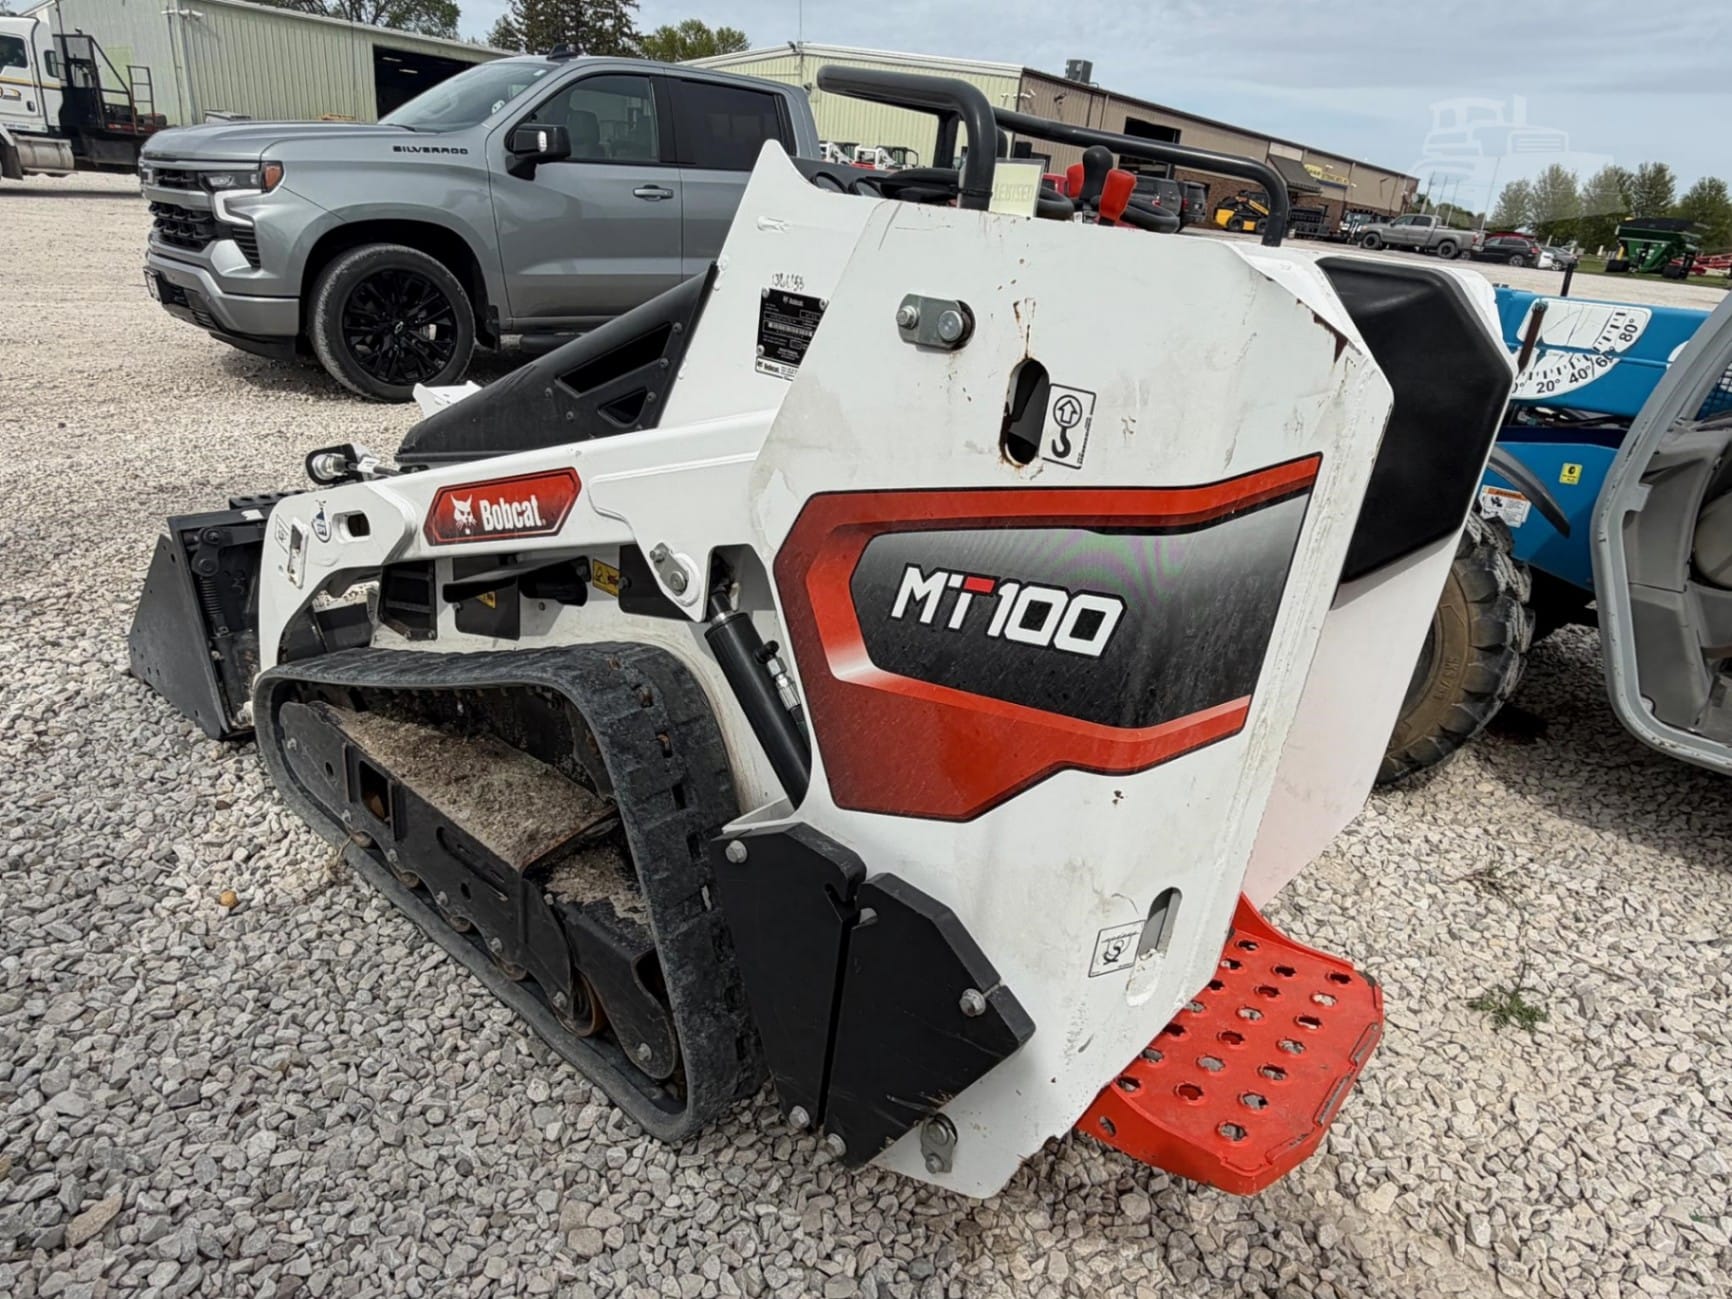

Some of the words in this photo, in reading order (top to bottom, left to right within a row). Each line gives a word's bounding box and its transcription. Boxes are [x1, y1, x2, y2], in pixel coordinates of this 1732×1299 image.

[392, 145, 469, 155] SILVERADO
[1568, 365, 1591, 384] 40°
[1535, 378, 1561, 394] 20°
[479, 494, 543, 532] Bobcat
[889, 564, 1126, 658] MT100
